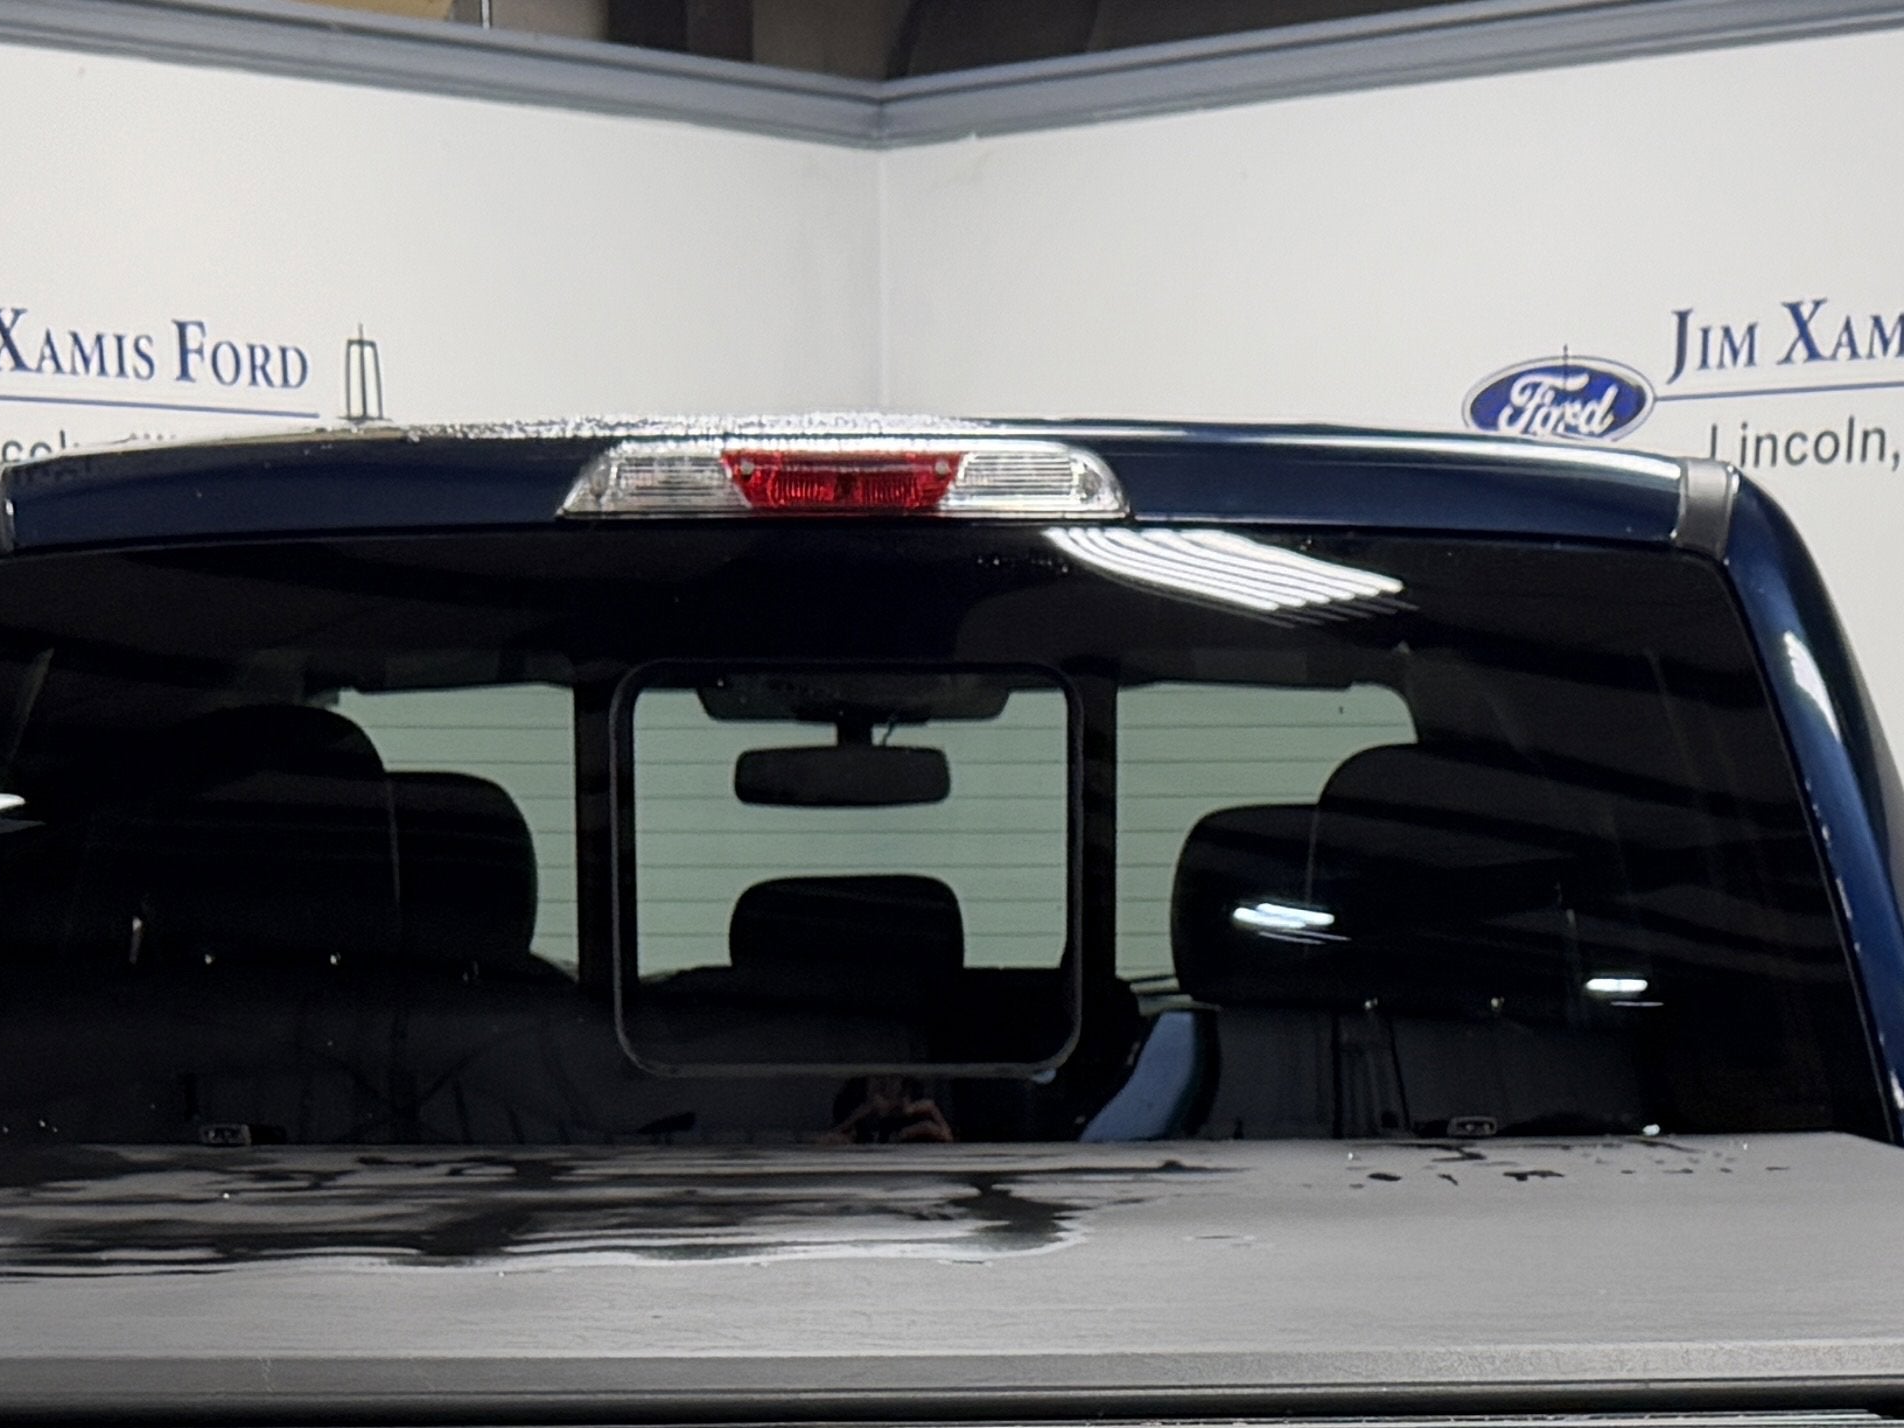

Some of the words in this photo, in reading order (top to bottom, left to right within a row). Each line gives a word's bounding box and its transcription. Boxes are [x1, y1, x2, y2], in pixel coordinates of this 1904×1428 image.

[172, 319, 310, 389] FORD
[1666, 308, 1759, 384] JIM
[1498, 373, 1618, 436] Ford
